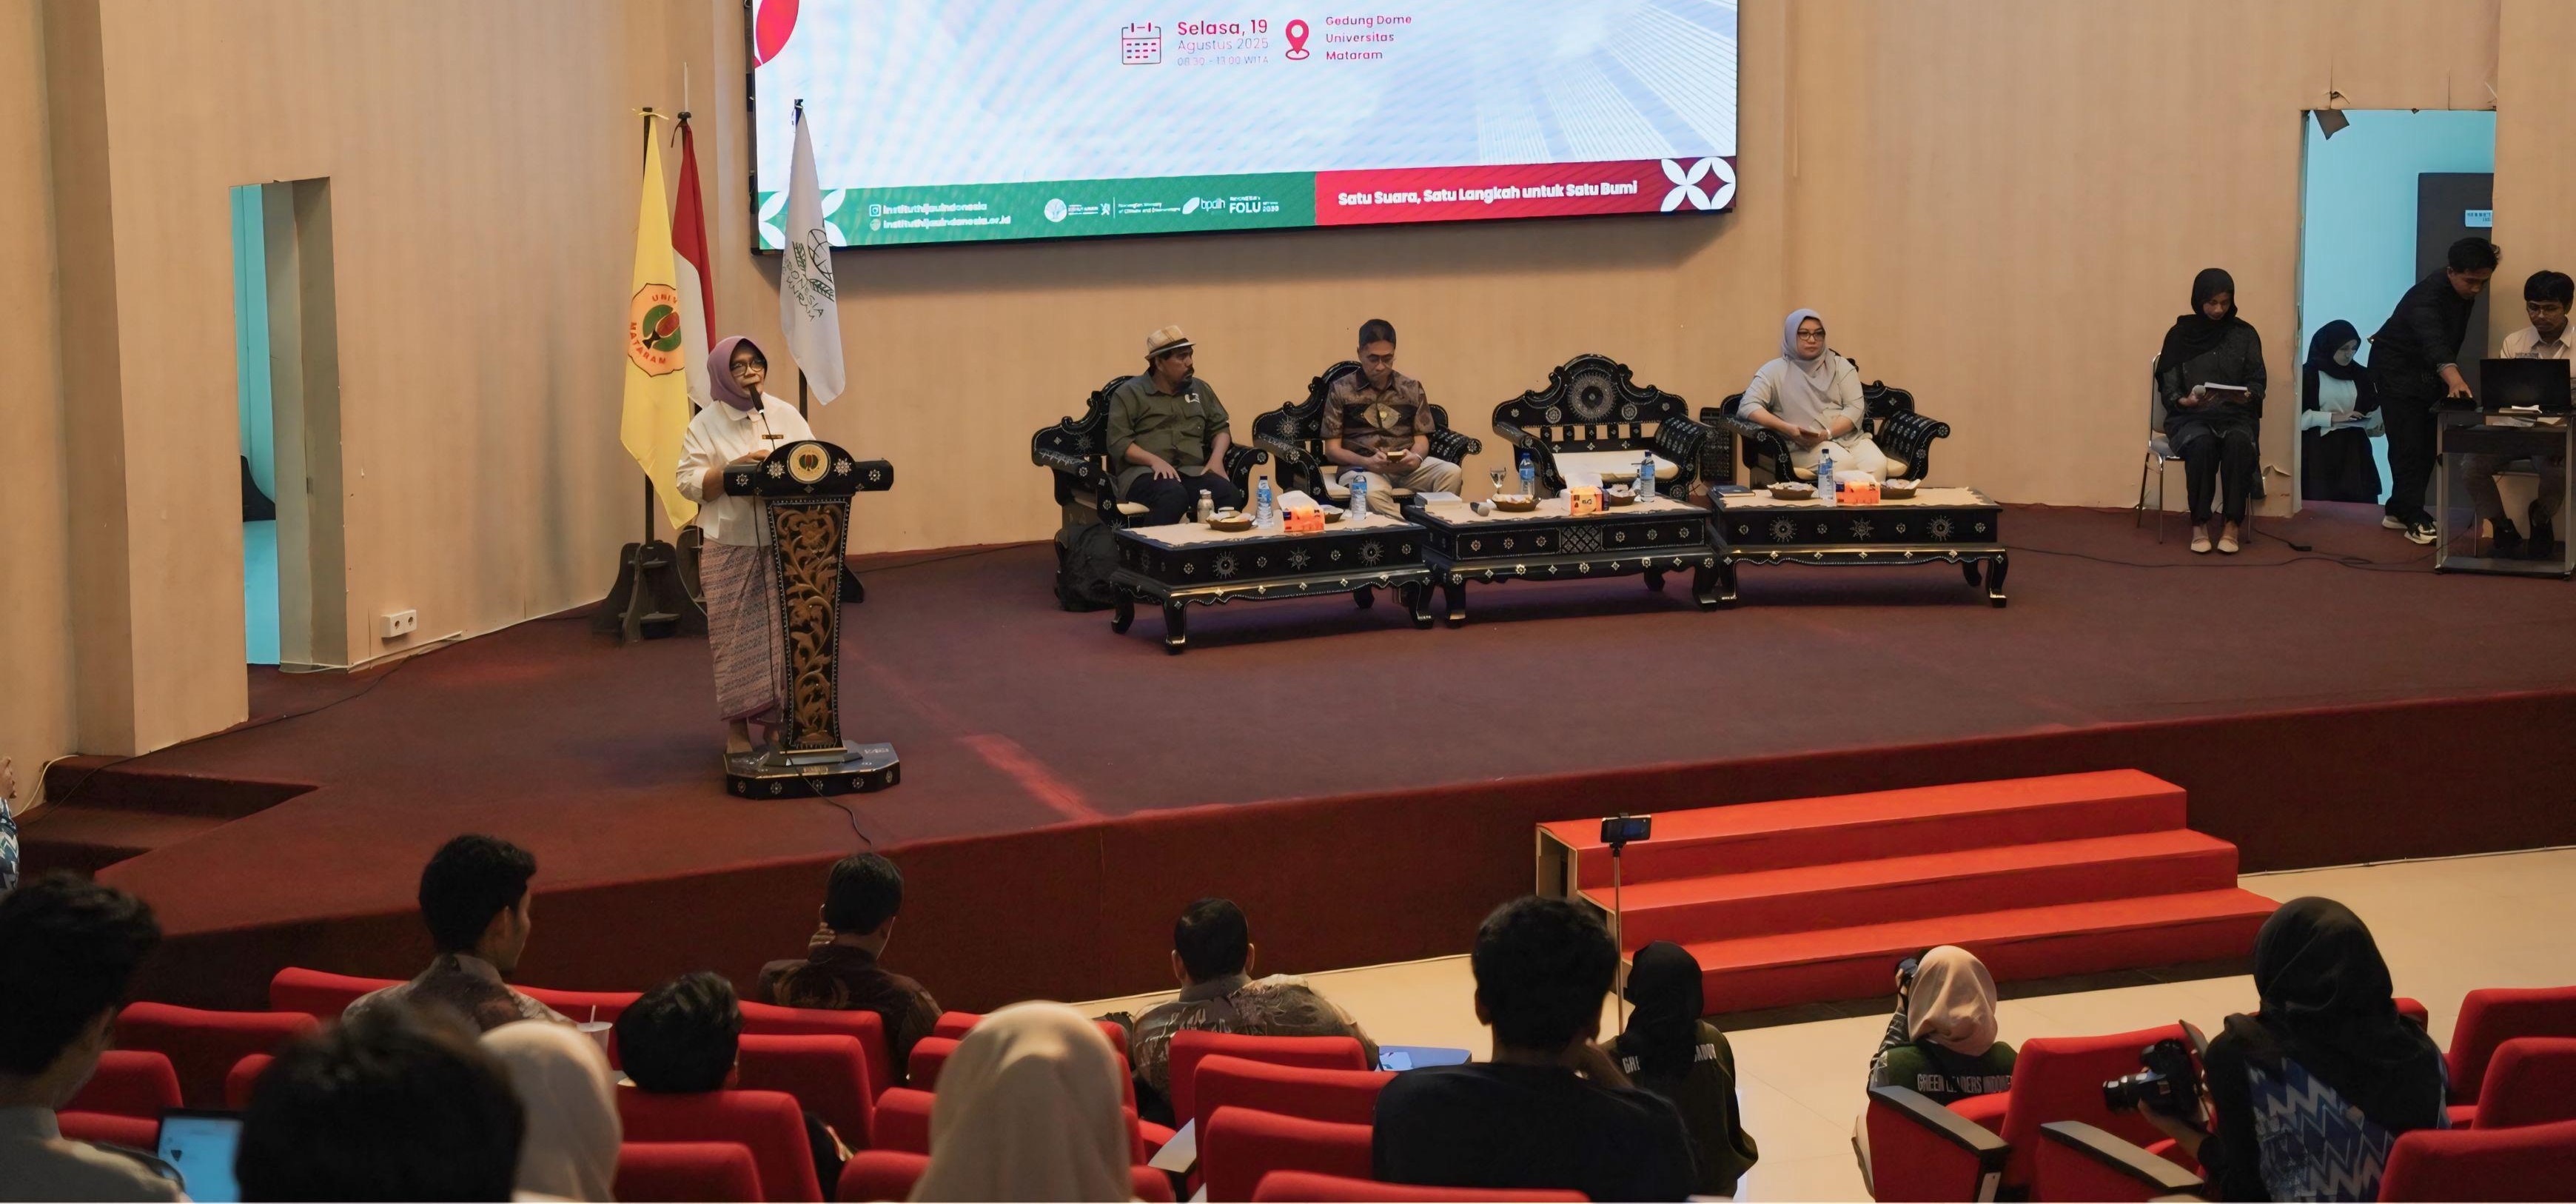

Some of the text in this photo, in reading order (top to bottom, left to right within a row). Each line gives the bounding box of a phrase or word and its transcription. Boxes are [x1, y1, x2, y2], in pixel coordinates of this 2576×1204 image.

[1178, 19, 1267, 36] Selasa, 19
[1326, 16, 1412, 28] Gedung Dome
[1326, 32, 1395, 43] Universitas
[1178, 38, 1269, 54] Agustus 2025
[1326, 51, 1383, 60] Mataram
[1338, 180, 1637, 206] Satu Suara, Satu Langkah untuk Satu Bumi
[1230, 201, 1261, 214] FOLU
